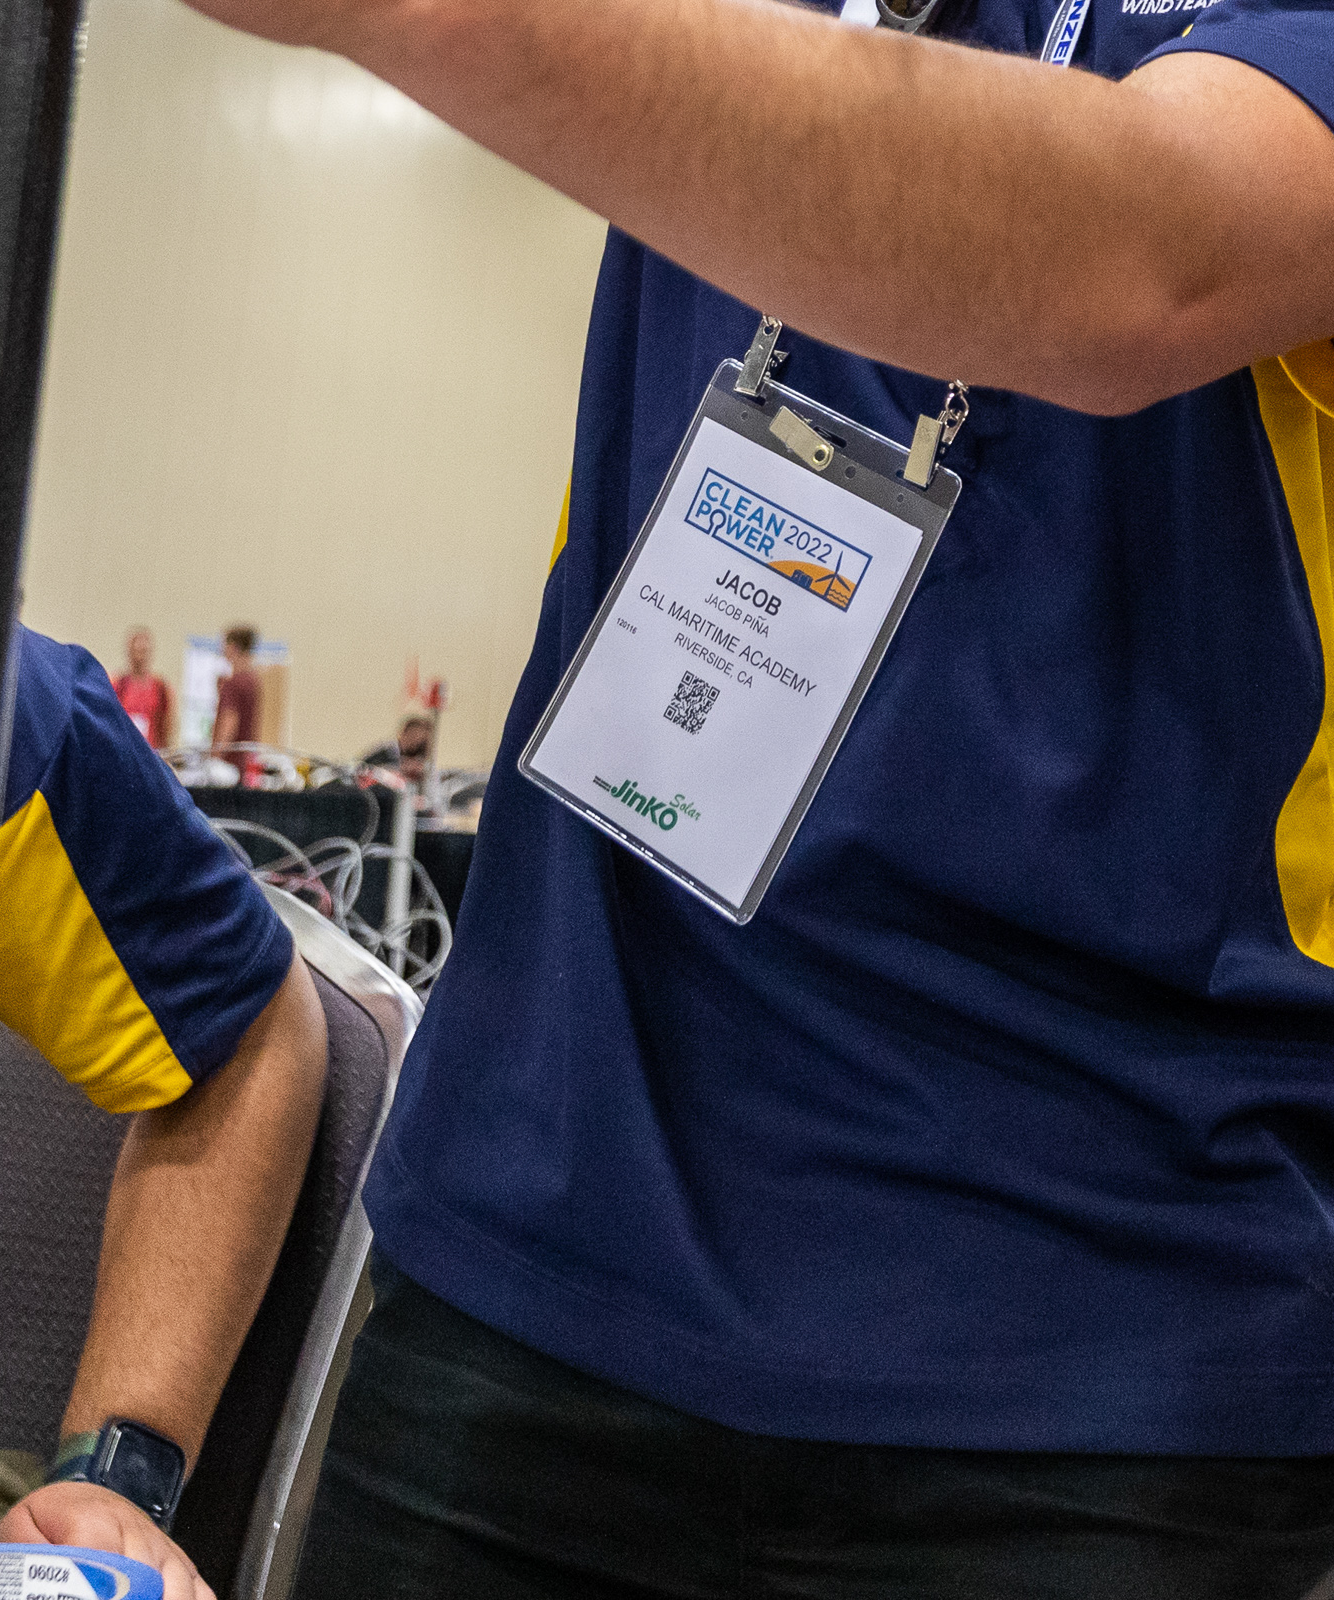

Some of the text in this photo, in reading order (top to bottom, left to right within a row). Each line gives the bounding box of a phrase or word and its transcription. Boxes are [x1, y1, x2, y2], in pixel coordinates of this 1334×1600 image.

[695, 499, 776, 558] POWER
[705, 481, 833, 564] CLEAN 2022
[704, 593, 770, 639] JACOB PIÑA
[716, 569, 782, 617] JACOB
[639, 584, 817, 698] CAL MARITIME ACADEMY
[674, 632, 754, 689] RIVERSIDE, CA
[669, 793, 701, 821] Solar
